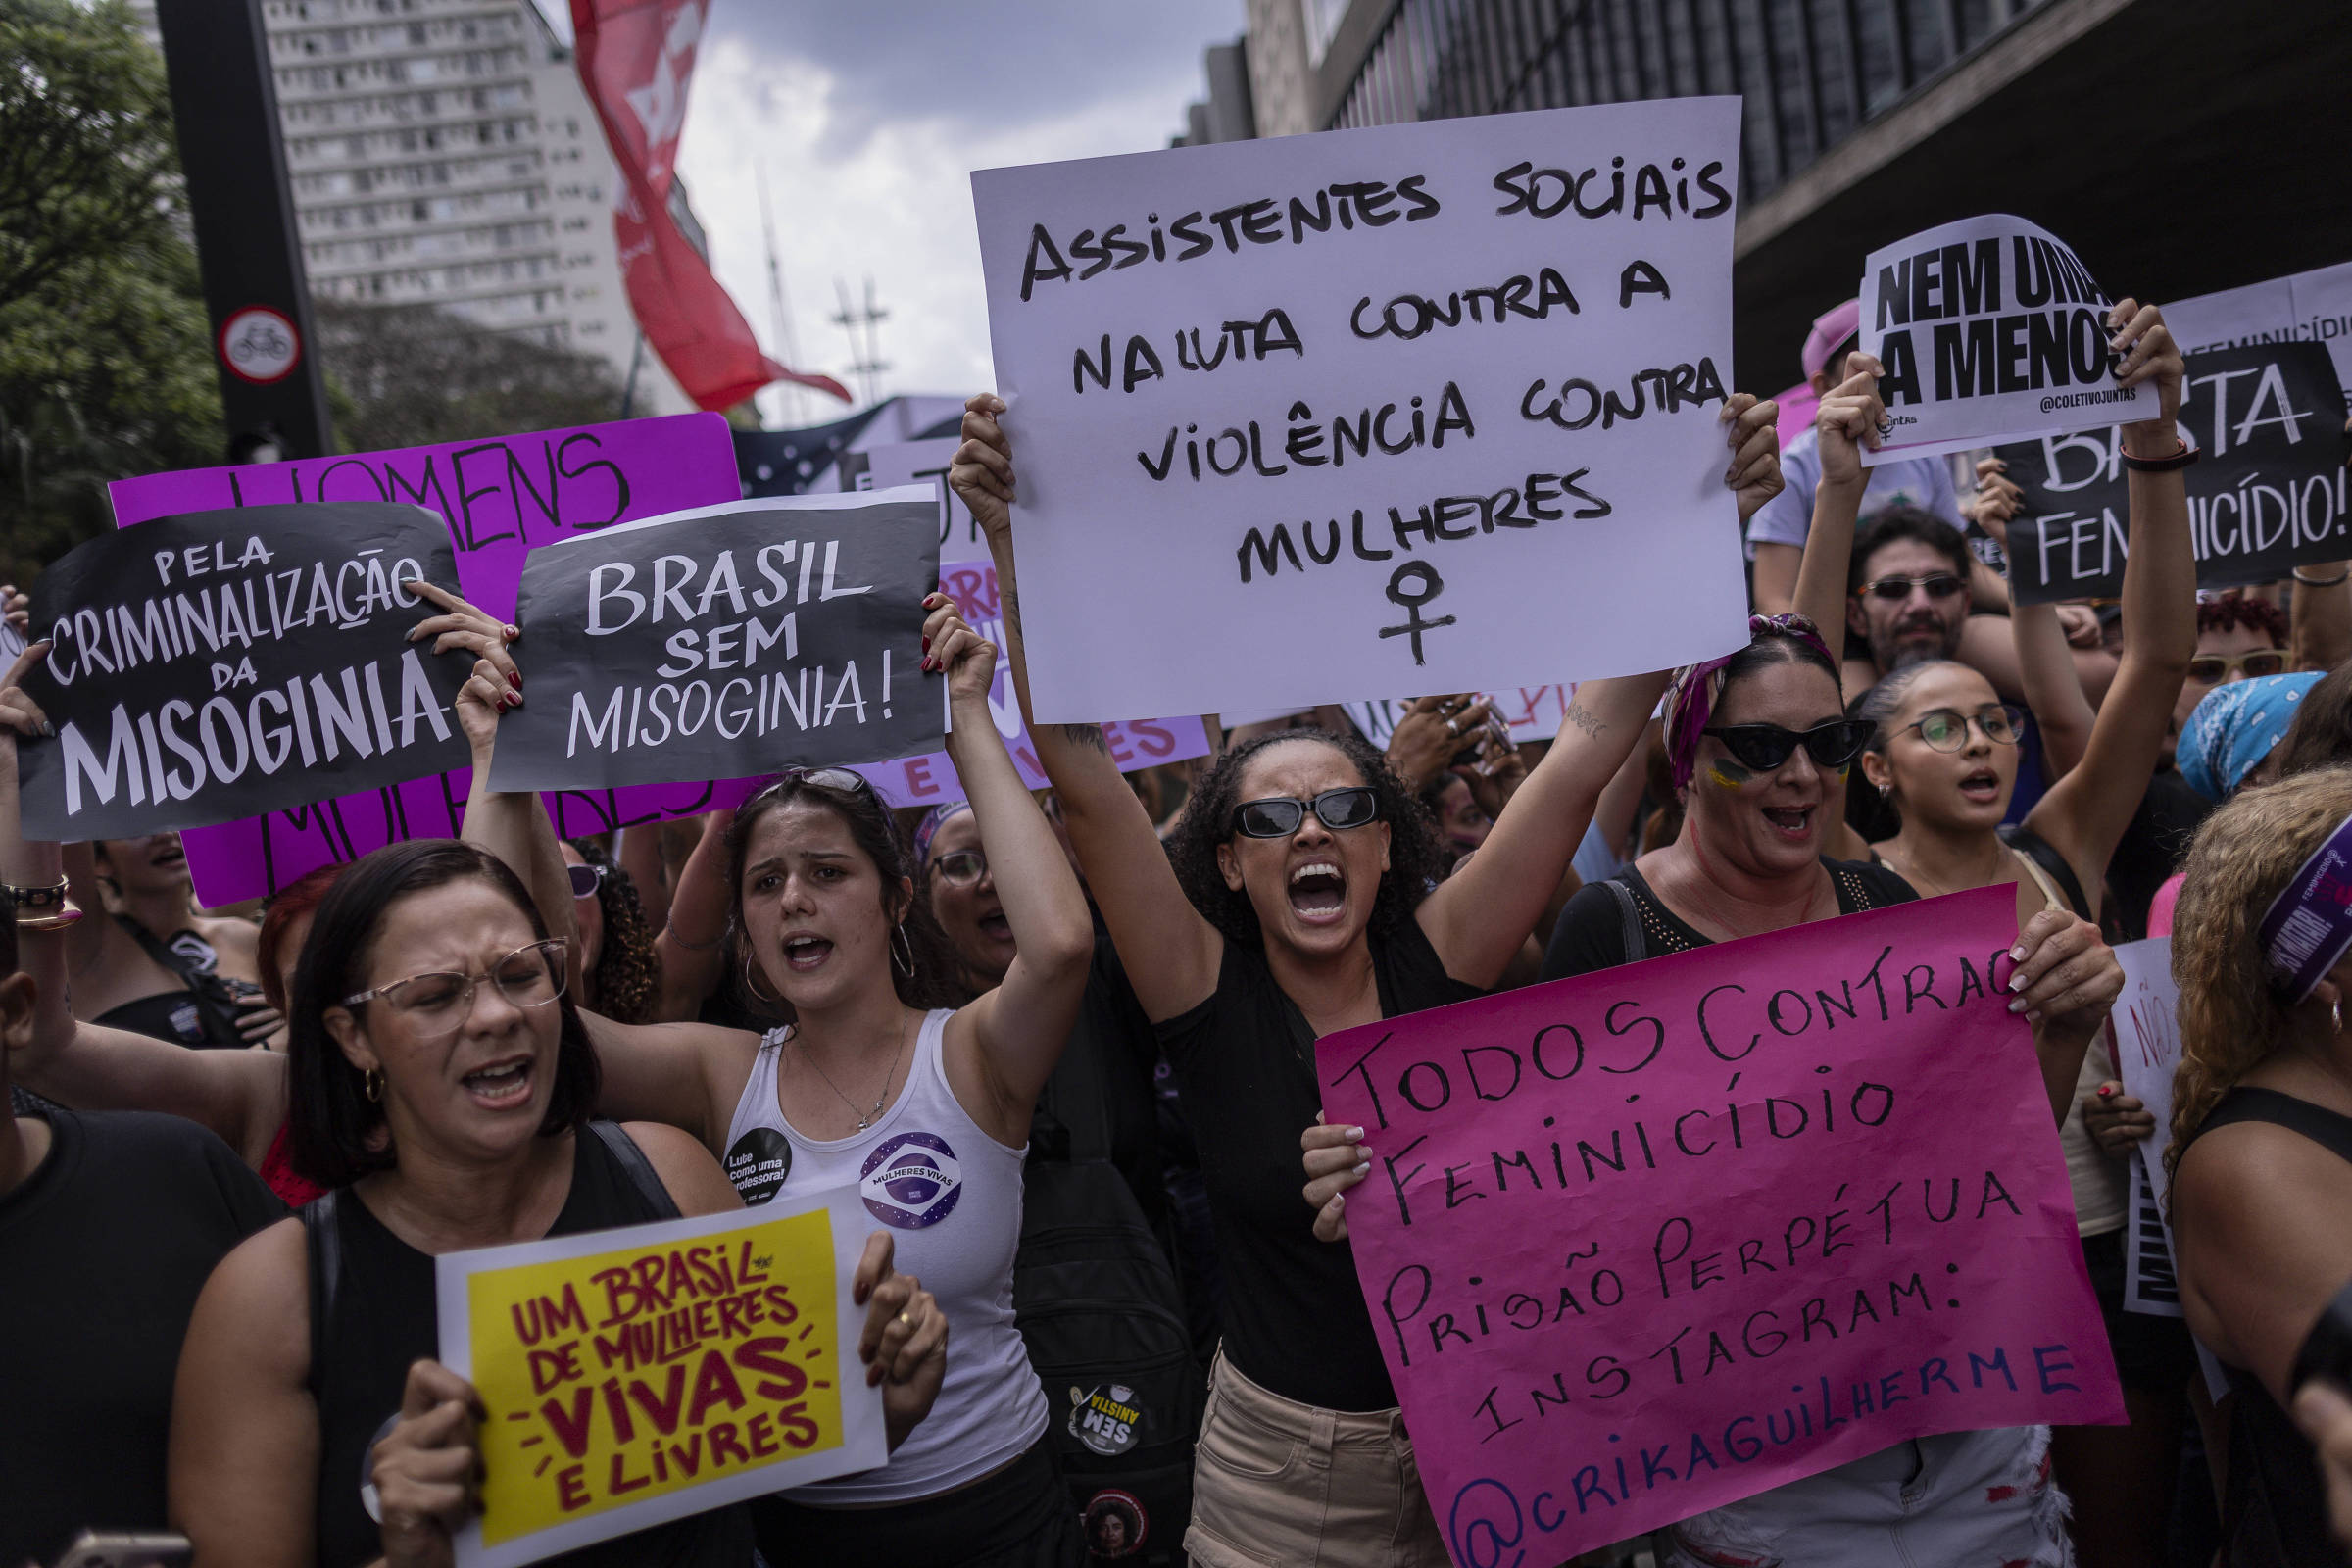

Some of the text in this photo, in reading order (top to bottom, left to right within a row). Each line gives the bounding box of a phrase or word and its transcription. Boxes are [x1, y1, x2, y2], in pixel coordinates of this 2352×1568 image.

[1350, 267, 1579, 341] CONTRA
[1619, 259, 1670, 309] A
[1875, 237, 2001, 333] NEM
[1520, 357, 1730, 430] CONTRA
[1878, 329, 1922, 408] A
[2040, 388, 2136, 413] @COLETIVOJUNTAS
[2042, 363, 2313, 491] BTA
[153, 534, 274, 587] PELA
[1238, 466, 1612, 584] MULHERES
[2037, 466, 2346, 586] FEICÍDIO!
[47, 548, 424, 686] CRIMINALIZAÇÃO
[584, 540, 873, 636] BRASIL
[211, 654, 258, 692] DA
[656, 612, 798, 678] SEM
[59, 648, 451, 815] MISOGINIA
[566, 649, 893, 759] MISOGINIA!
[1331, 999, 1665, 1130] TODOS
[728, 1152, 754, 1168] Lute
[729, 1158, 783, 1181] como uma
[737, 1167, 785, 1192] rofessora!
[872, 1167, 953, 1187] MULHERES VIVAS
[1654, 1170, 2022, 1298] PERPÉTUA
[510, 1239, 768, 1347] UM BRASIL
[527, 1284, 799, 1396] DE MULHERES
[540, 1336, 808, 1459] VIVAS
[1083, 1409, 1132, 1444] SEM
[1092, 1395, 1139, 1424] ANISTIA
[554, 1401, 820, 1513] E LIVRES
